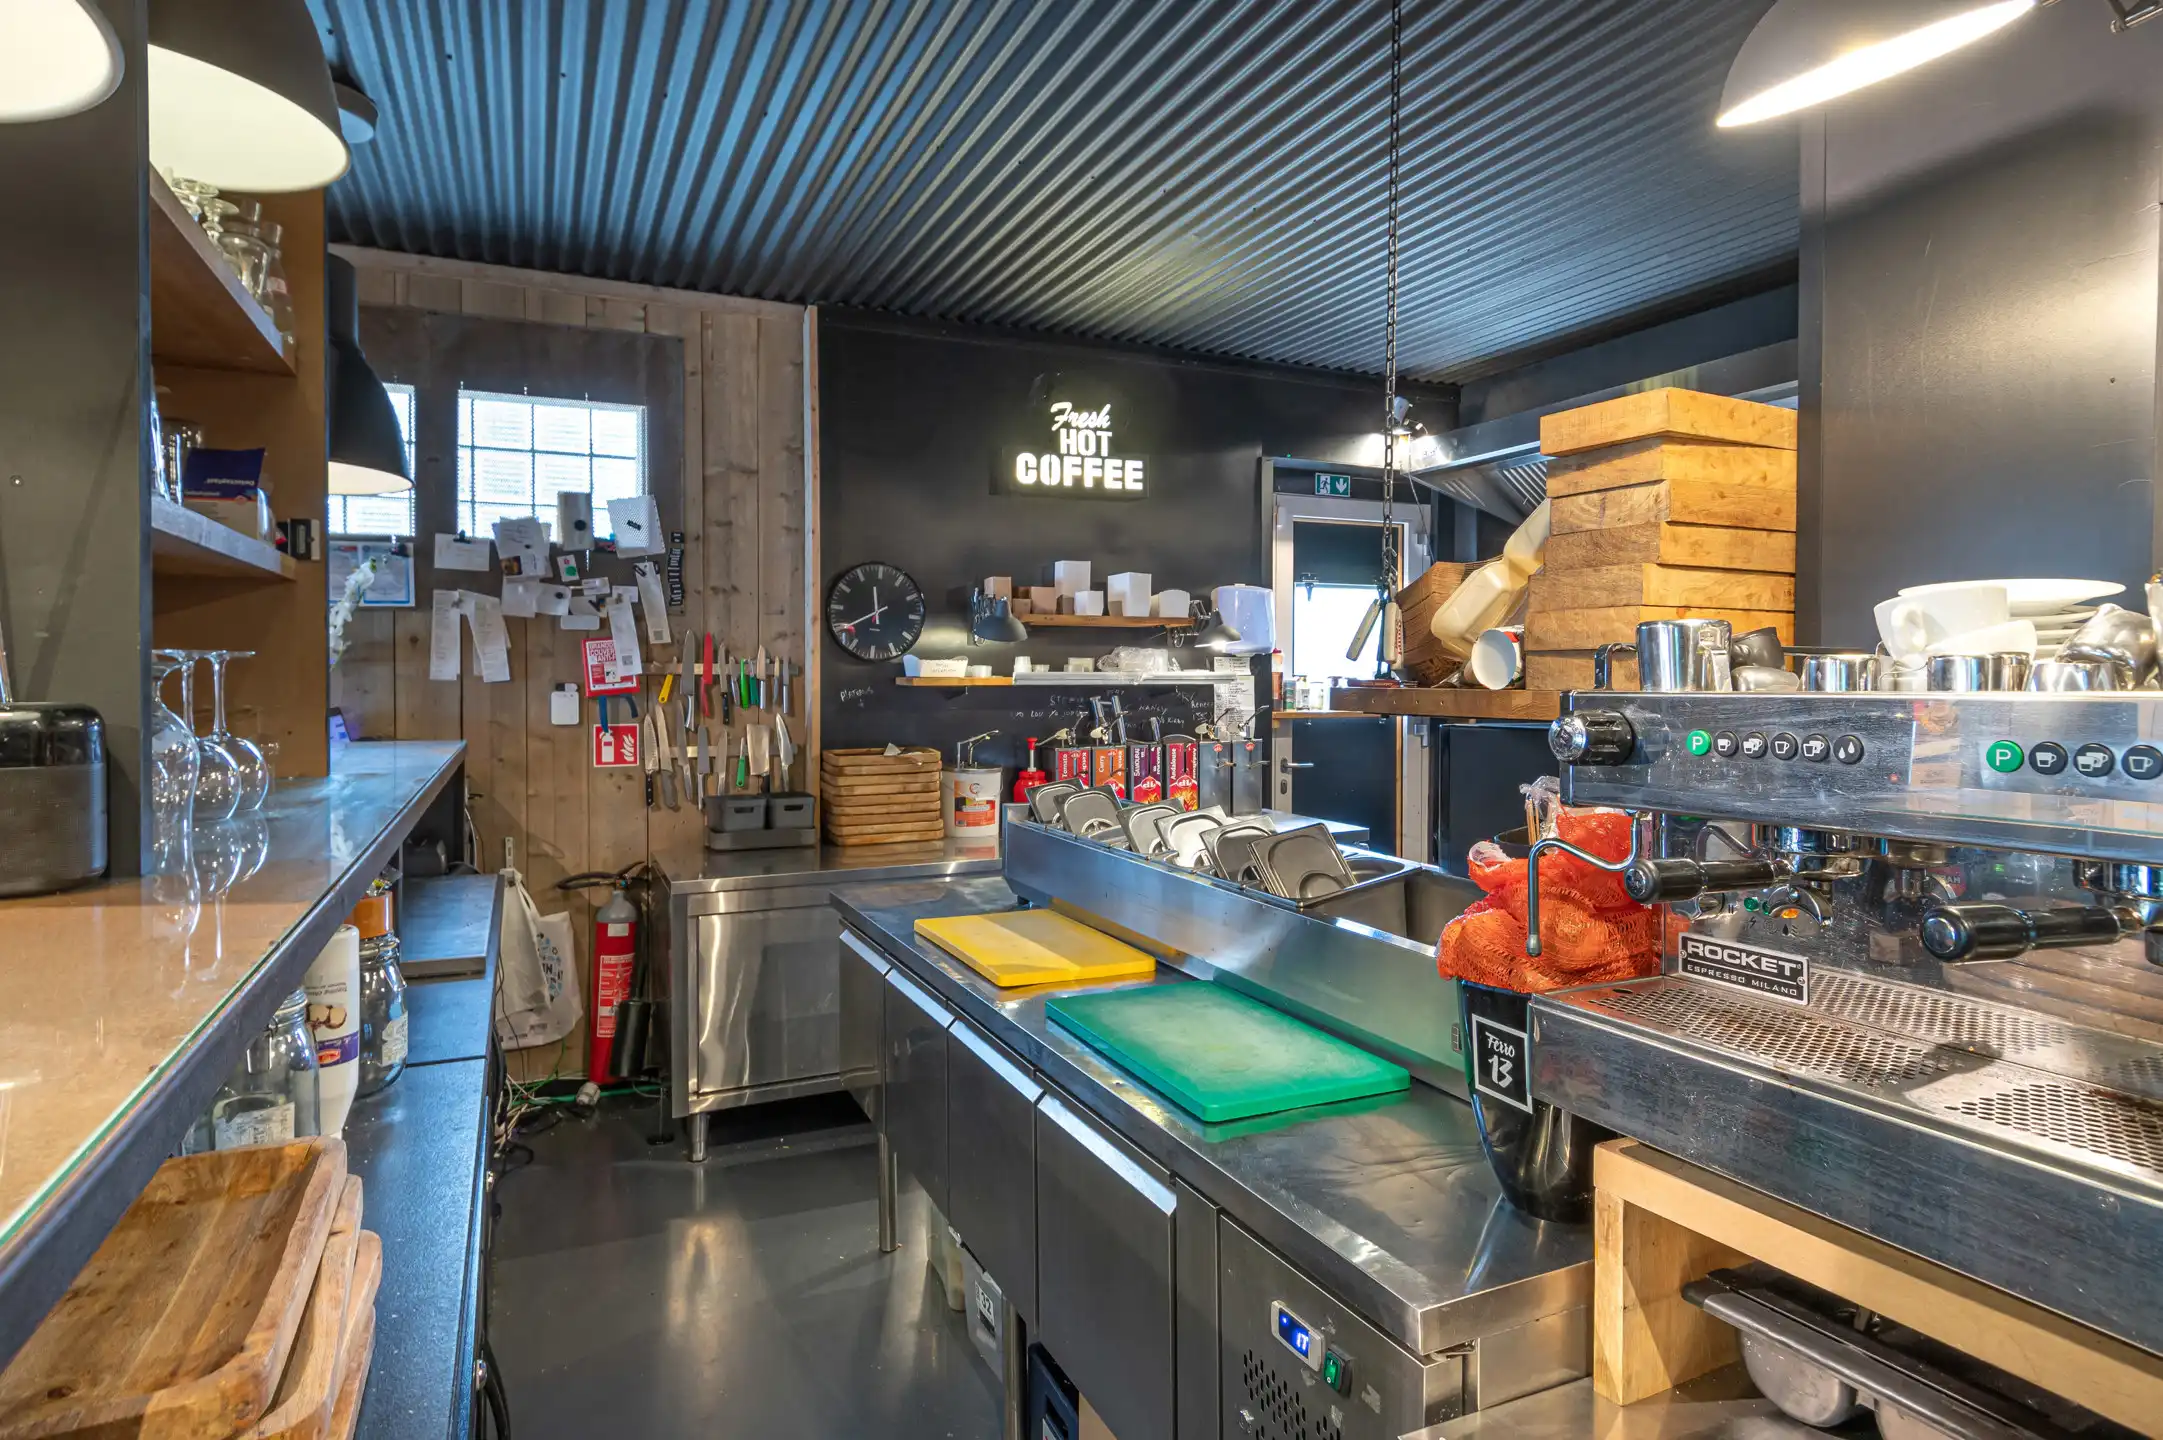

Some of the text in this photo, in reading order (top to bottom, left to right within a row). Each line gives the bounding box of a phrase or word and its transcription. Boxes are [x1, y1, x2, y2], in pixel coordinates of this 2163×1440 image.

[1050, 401, 1112, 432] Fresh
[1059, 429, 1112, 457] HOT
[1015, 452, 1144, 491] COFFEE
[1691, 735, 1704, 750] P
[1098, 755, 1106, 773] Curry
[1995, 748, 2012, 766] P
[1687, 940, 1797, 977] ROCKET
[1687, 964, 1745, 984] ESPRESSO
[1751, 979, 1798, 996] MILANO
[1484, 1031, 1516, 1058] Ferro
[1487, 1054, 1513, 1089] 13
